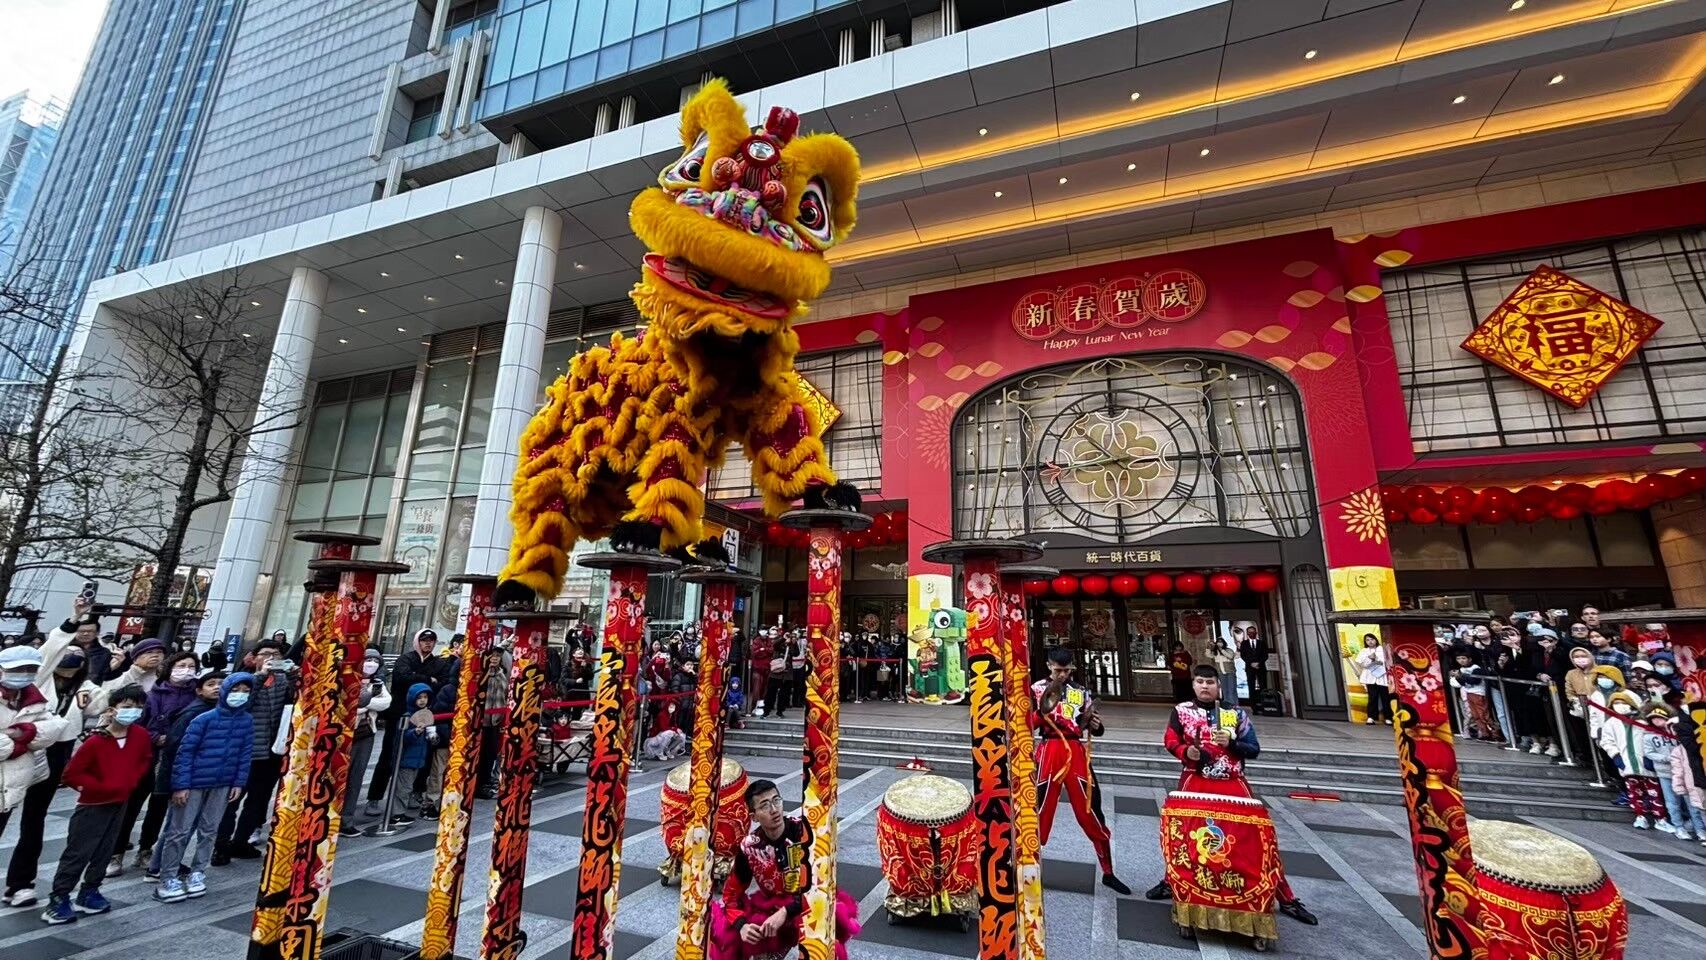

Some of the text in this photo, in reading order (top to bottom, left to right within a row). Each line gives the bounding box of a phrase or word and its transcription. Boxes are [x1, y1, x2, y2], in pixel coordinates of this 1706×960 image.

[1026, 281, 1190, 328] 新春賀歲
[1043, 327, 1171, 350] Happy Lunar New Year
[1521, 307, 1596, 359] 福
[1086, 550, 1162, 563] 統一時代百貨
[925, 581, 935, 595] 8
[1355, 575, 1369, 588] 6
